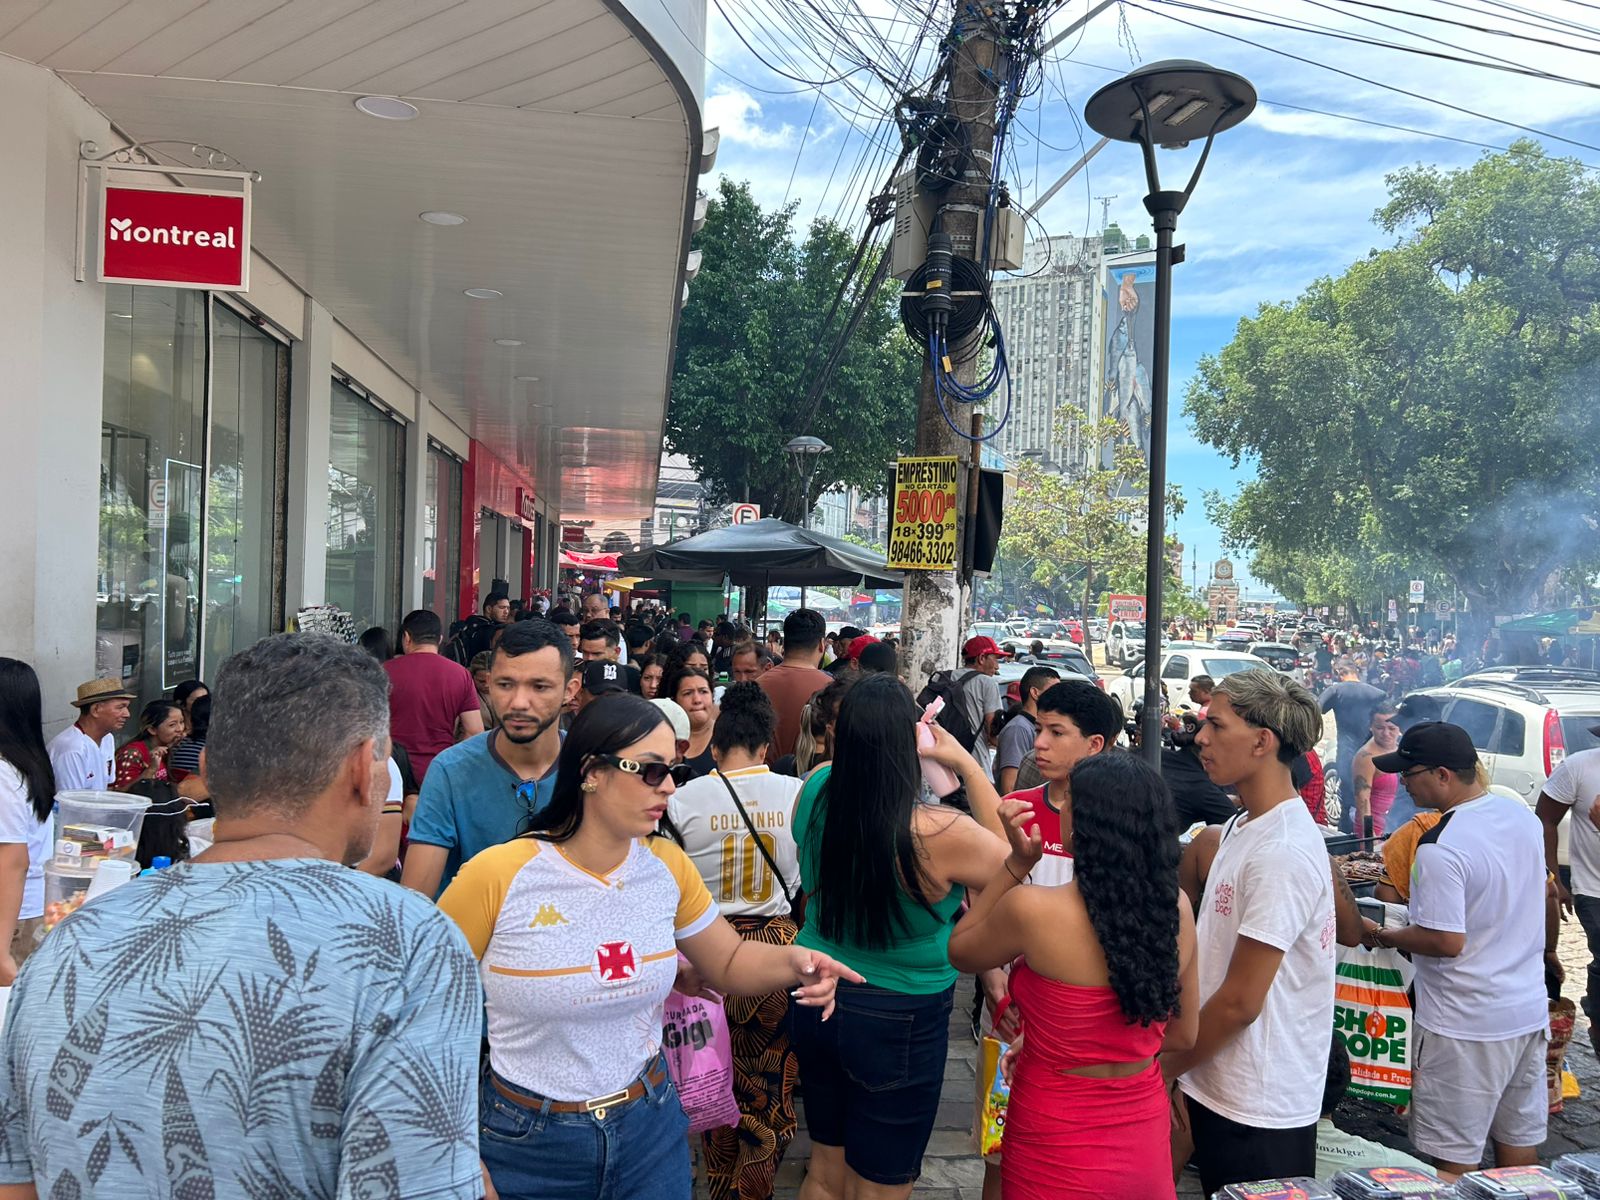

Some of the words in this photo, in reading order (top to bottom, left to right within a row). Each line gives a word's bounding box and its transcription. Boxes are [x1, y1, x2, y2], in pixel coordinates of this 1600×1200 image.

[110, 217, 236, 249] Montreal
[890, 540, 954, 564] 98466-3302
[710, 811, 784, 832] COUINHO
[719, 831, 777, 904] 10
